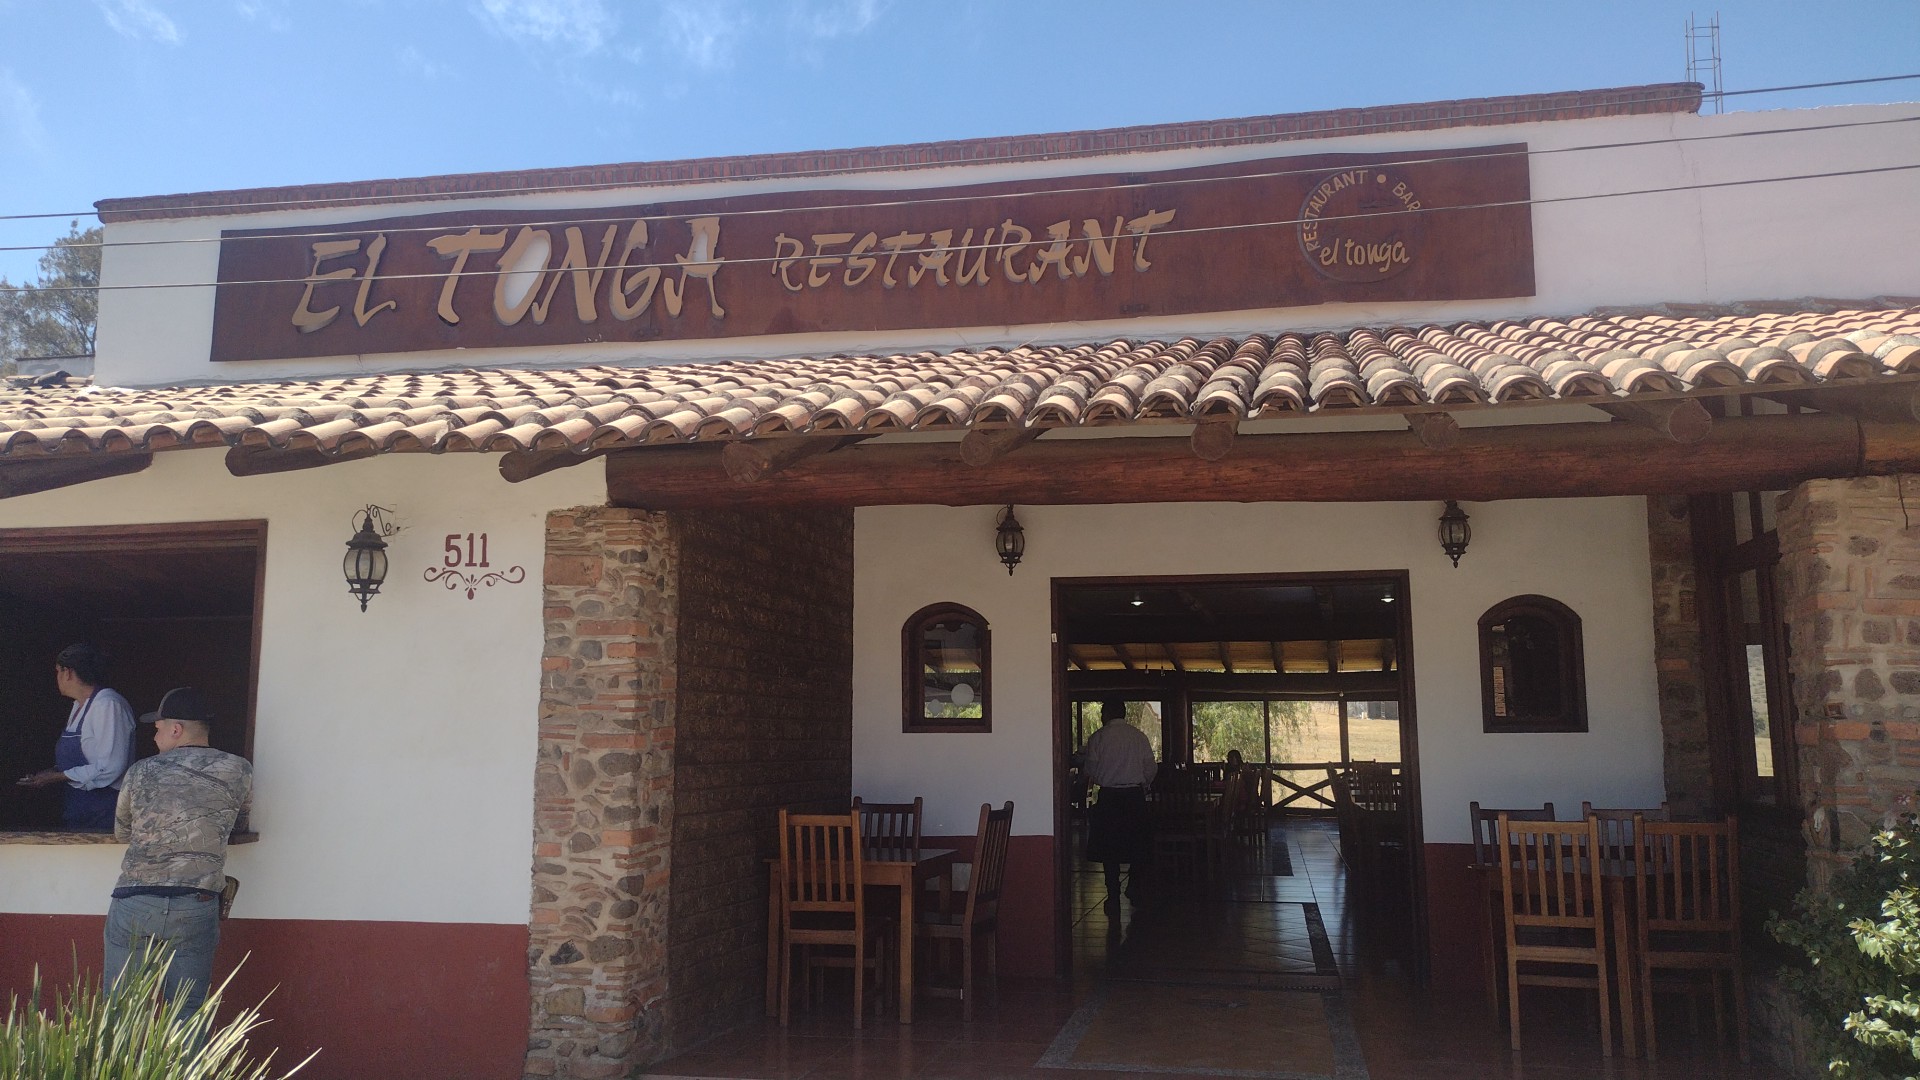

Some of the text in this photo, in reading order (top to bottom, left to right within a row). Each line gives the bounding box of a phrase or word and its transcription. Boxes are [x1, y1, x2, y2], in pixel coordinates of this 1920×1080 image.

[1303, 170, 1421, 251] RESTAURANT BAR
[292, 208, 1177, 329] EL TONGA RESTAURANT
[1320, 238, 1410, 273] el tonga
[444, 532, 490, 568] 511
